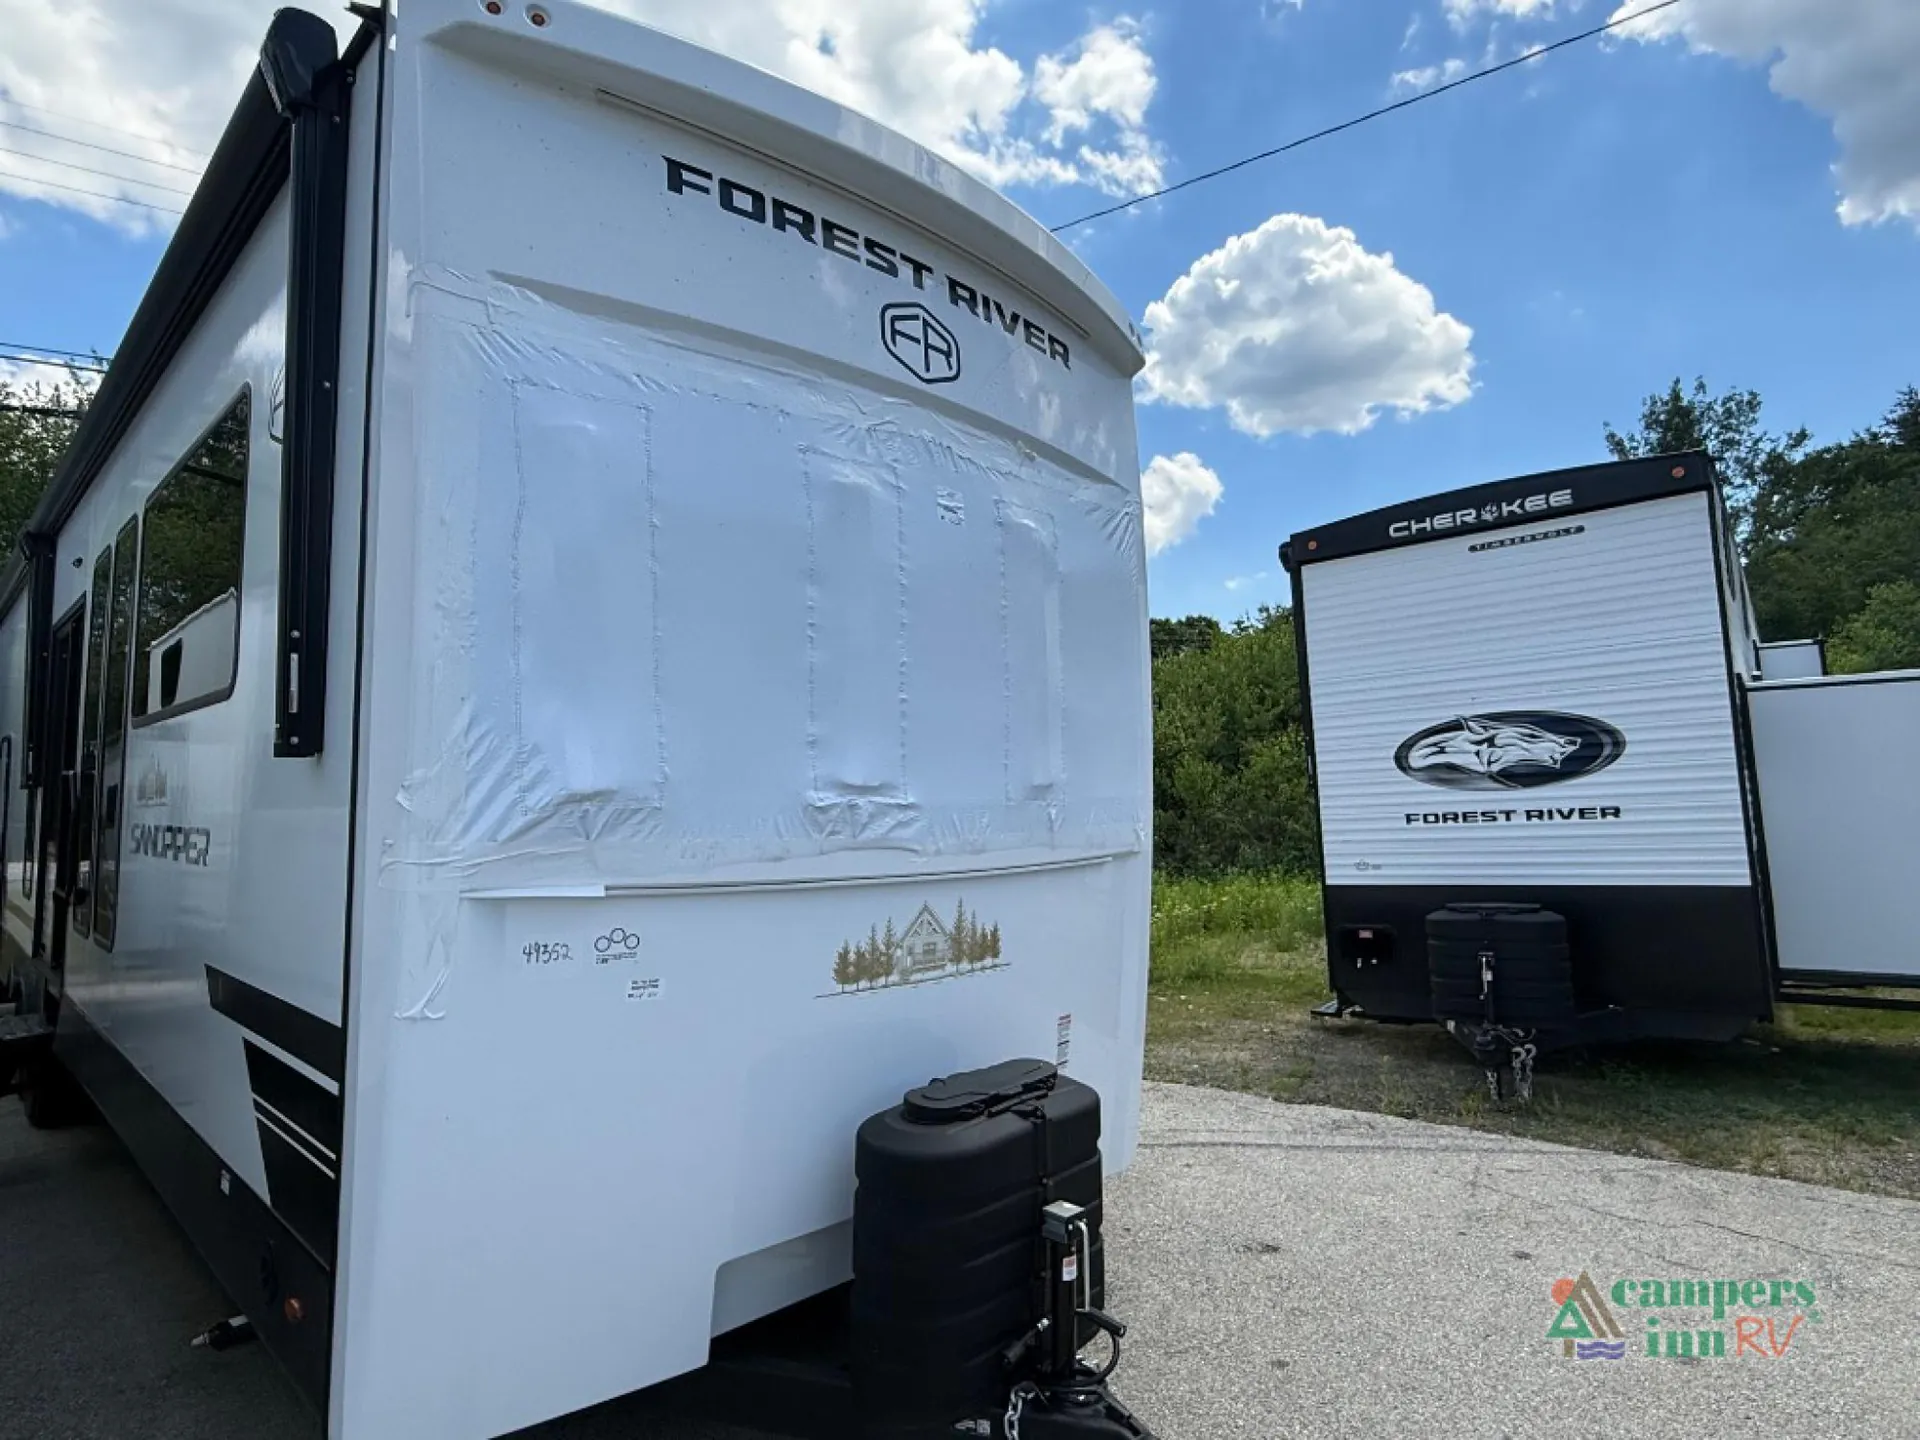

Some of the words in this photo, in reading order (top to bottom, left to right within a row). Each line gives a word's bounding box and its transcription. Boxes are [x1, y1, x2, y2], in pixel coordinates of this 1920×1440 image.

[660, 154, 934, 290] FOREST
[944, 273, 1071, 370] RIVER
[1404, 809, 1517, 825] FOREST
[1524, 805, 1622, 822] RIVER
[522, 942, 574, 965] 49352
